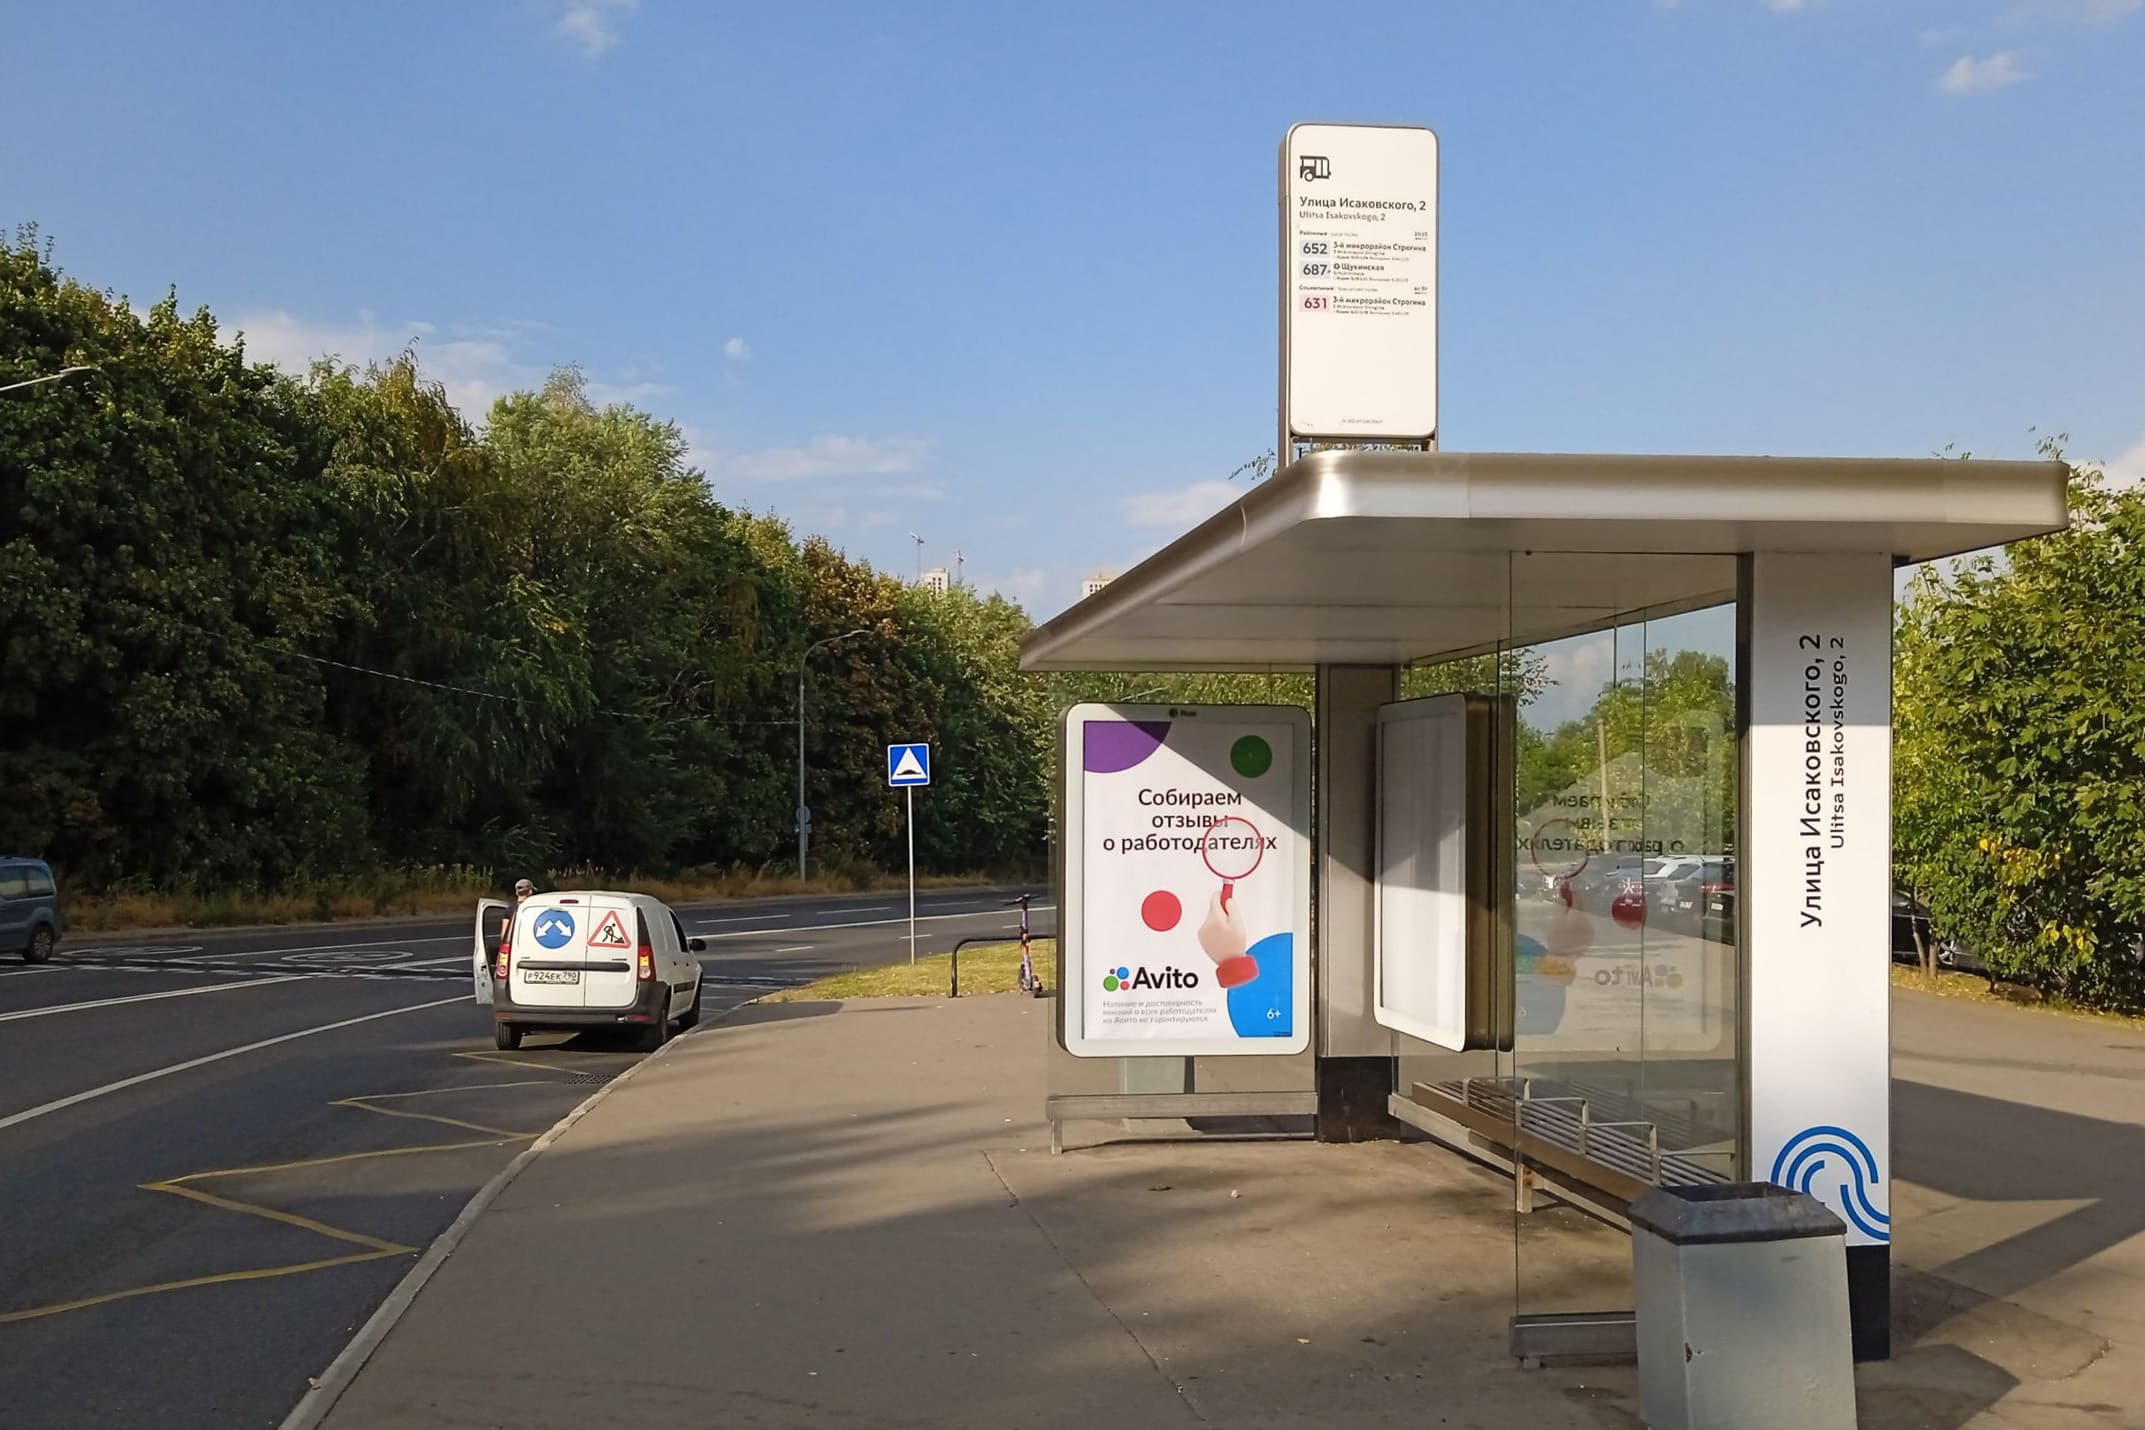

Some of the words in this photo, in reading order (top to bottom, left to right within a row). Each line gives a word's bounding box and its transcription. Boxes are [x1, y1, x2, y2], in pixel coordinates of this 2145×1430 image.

[1299, 196, 1336, 209] Улица
[1340, 197, 1417, 212] Исаковского,
[1419, 200, 1426, 211] 2
[1299, 211, 1324, 219] Ulitsa
[1380, 213, 1386, 221] 2
[1303, 243, 1328, 255] 652
[1304, 297, 1327, 309] 631
[1800, 634, 1821, 650] 2
[1830, 636, 1845, 649] 2
[1830, 654, 1847, 787] Isakovskogo,
[1800, 658, 1825, 837] Исаковского,
[1138, 788, 1242, 808] Собираем
[1151, 815, 1229, 828] отзывы
[1830, 793, 1845, 849] Ulitsa
[1103, 837, 1115, 851] о
[1121, 833, 1277, 854] работодателях
[1800, 846, 1825, 928] Улица
[1131, 966, 1199, 989] Avito
[1266, 1008, 1281, 1020] 6+
